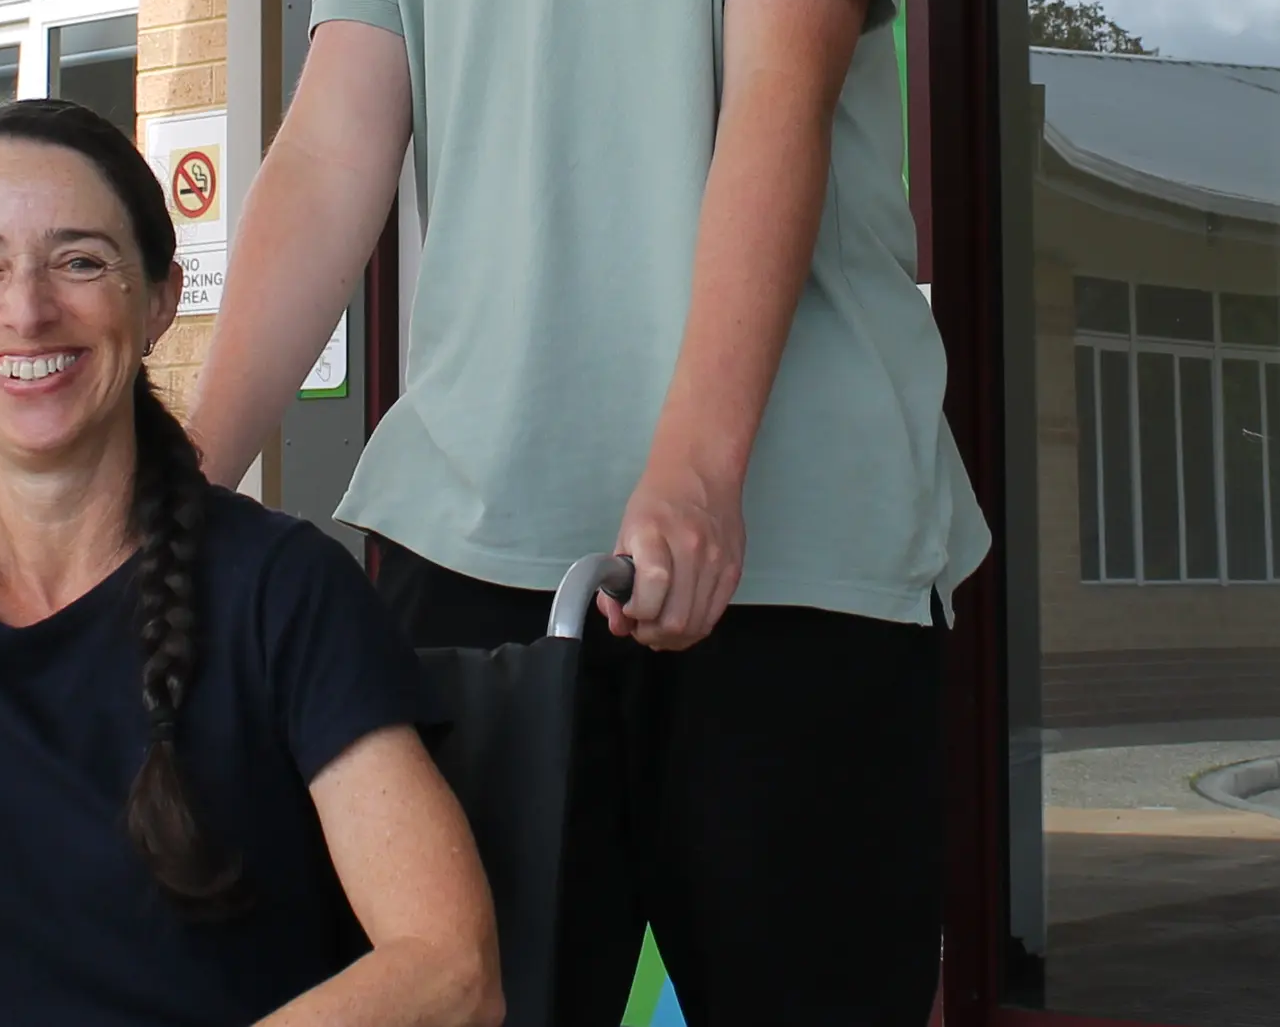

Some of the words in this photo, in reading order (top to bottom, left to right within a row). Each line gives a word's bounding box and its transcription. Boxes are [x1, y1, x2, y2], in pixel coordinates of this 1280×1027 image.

[181, 258, 200, 271] NO
[182, 272, 223, 288] OKING
[181, 290, 209, 304] REA
